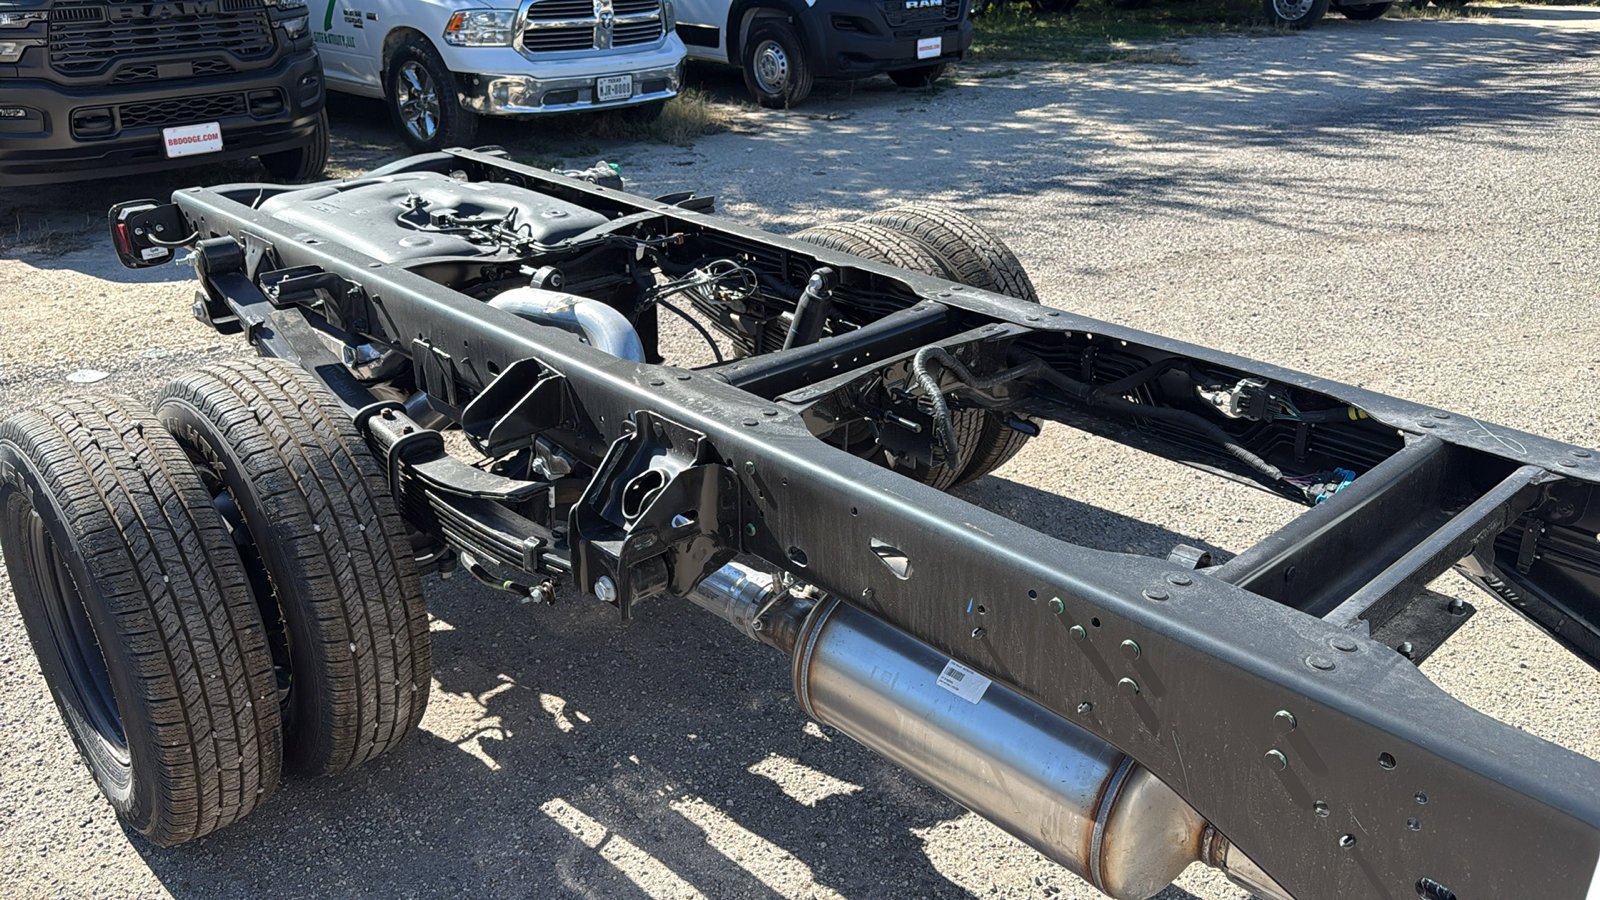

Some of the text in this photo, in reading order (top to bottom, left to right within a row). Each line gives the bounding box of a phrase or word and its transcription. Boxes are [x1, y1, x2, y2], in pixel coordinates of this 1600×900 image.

[108, 1, 217, 20] RAM
[906, 0, 942, 8] RAM
[168, 133, 218, 146] BBDODGE.COM
